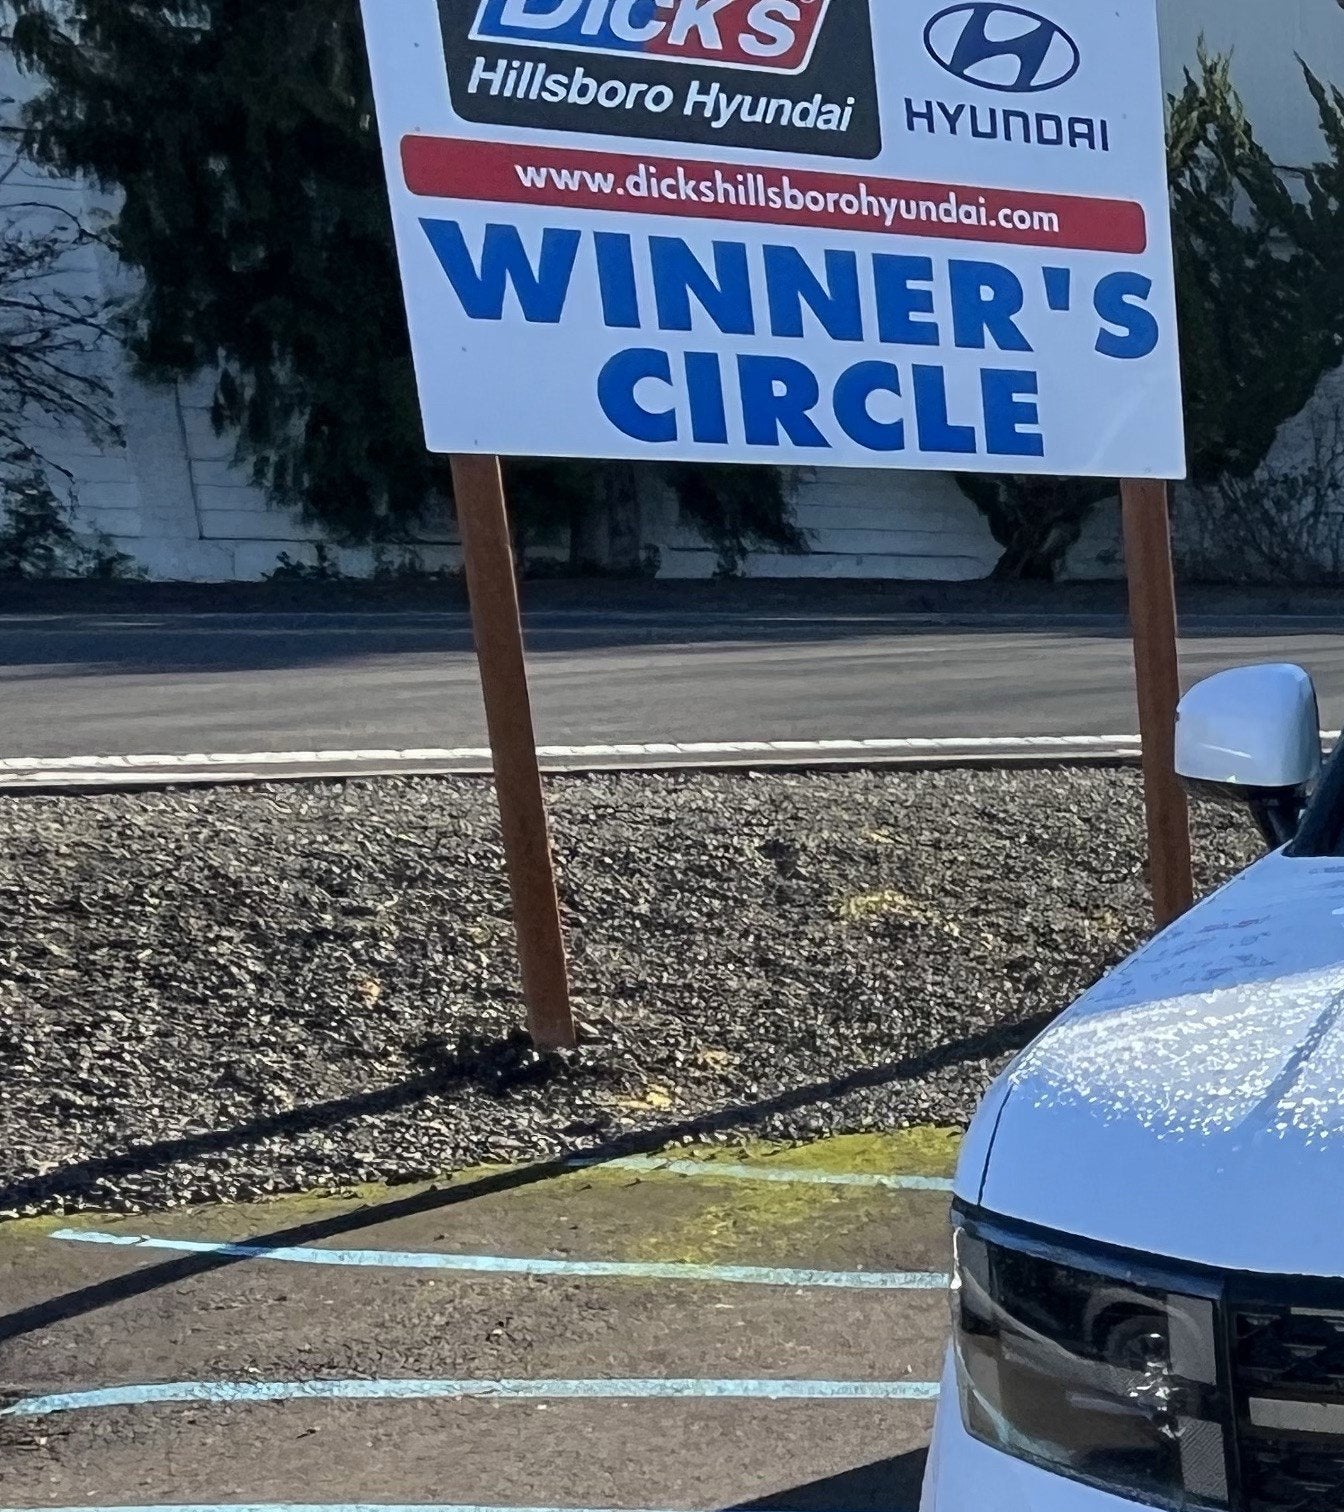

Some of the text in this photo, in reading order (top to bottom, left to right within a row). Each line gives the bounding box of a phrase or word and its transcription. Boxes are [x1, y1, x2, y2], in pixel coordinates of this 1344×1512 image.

[500, 0, 801, 57] cks
[467, 56, 855, 132] Hillsboro Hyundai
[905, 97, 1109, 152] HYUNDAI
[514, 161, 1060, 233] www.dickshillsborohyundai.com
[418, 217, 1160, 360] WINNER'S
[597, 347, 1045, 458] CIRCLE
